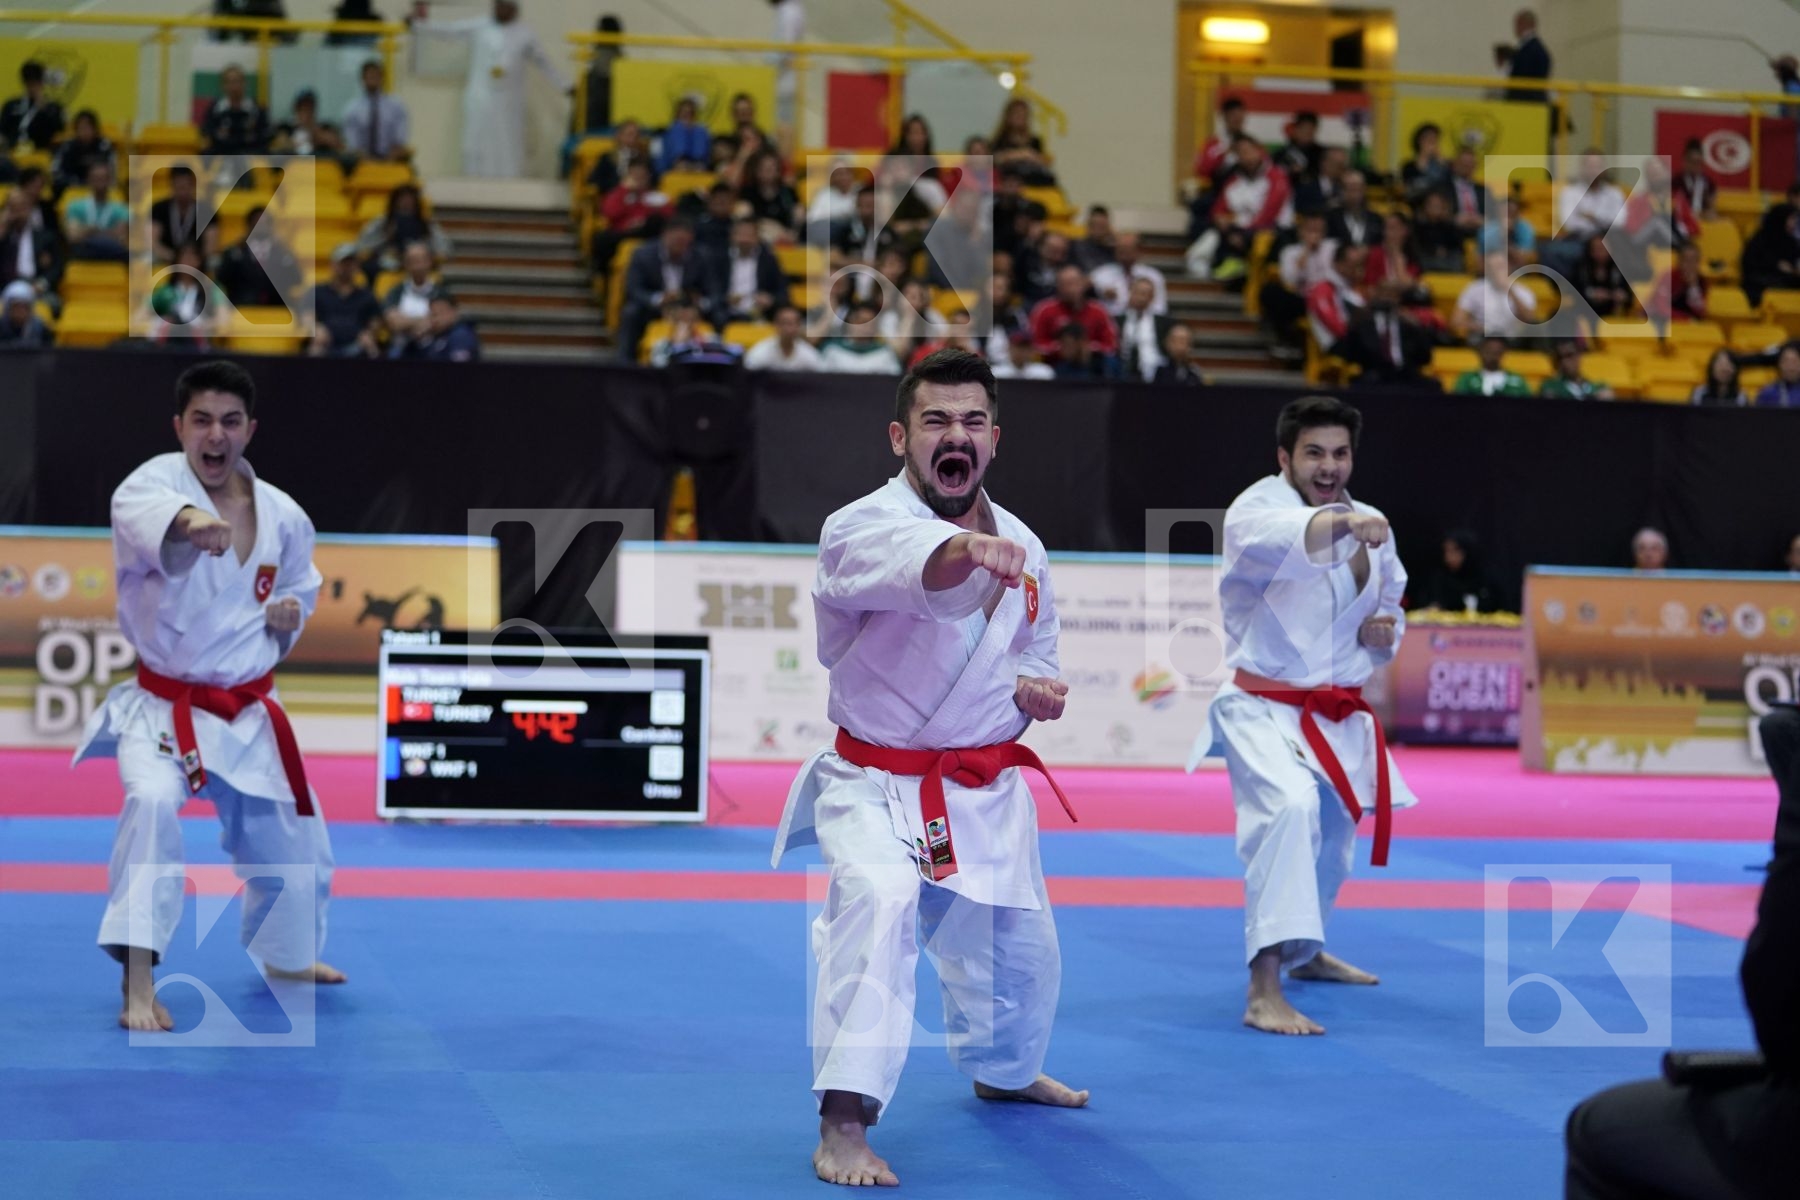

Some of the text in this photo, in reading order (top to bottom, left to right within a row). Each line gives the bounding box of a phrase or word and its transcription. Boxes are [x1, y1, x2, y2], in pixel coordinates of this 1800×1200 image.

[36, 631, 137, 684] OP
[1429, 661, 1507, 686] OPEN
[402, 686, 461, 703] TURKEY
[1428, 687, 1506, 711] DUBAI
[433, 704, 493, 722] TURKEY
